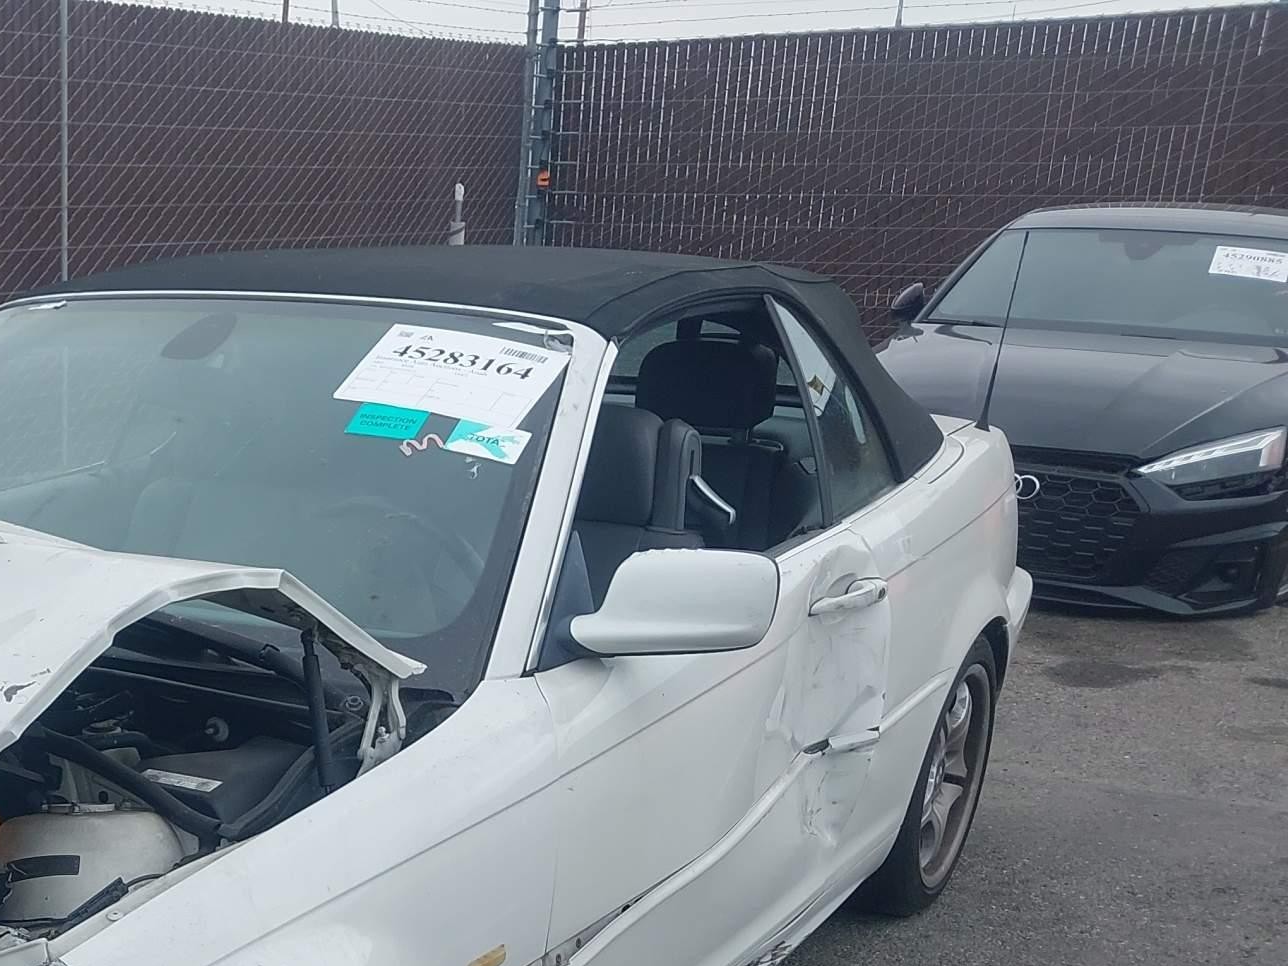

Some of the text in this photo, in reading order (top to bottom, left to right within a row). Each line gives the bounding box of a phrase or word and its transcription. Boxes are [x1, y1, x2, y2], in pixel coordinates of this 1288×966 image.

[393, 344, 534, 381] 45283164
[359, 412, 418, 425] INSPECTION
[359, 420, 411, 431] COMPLETE
